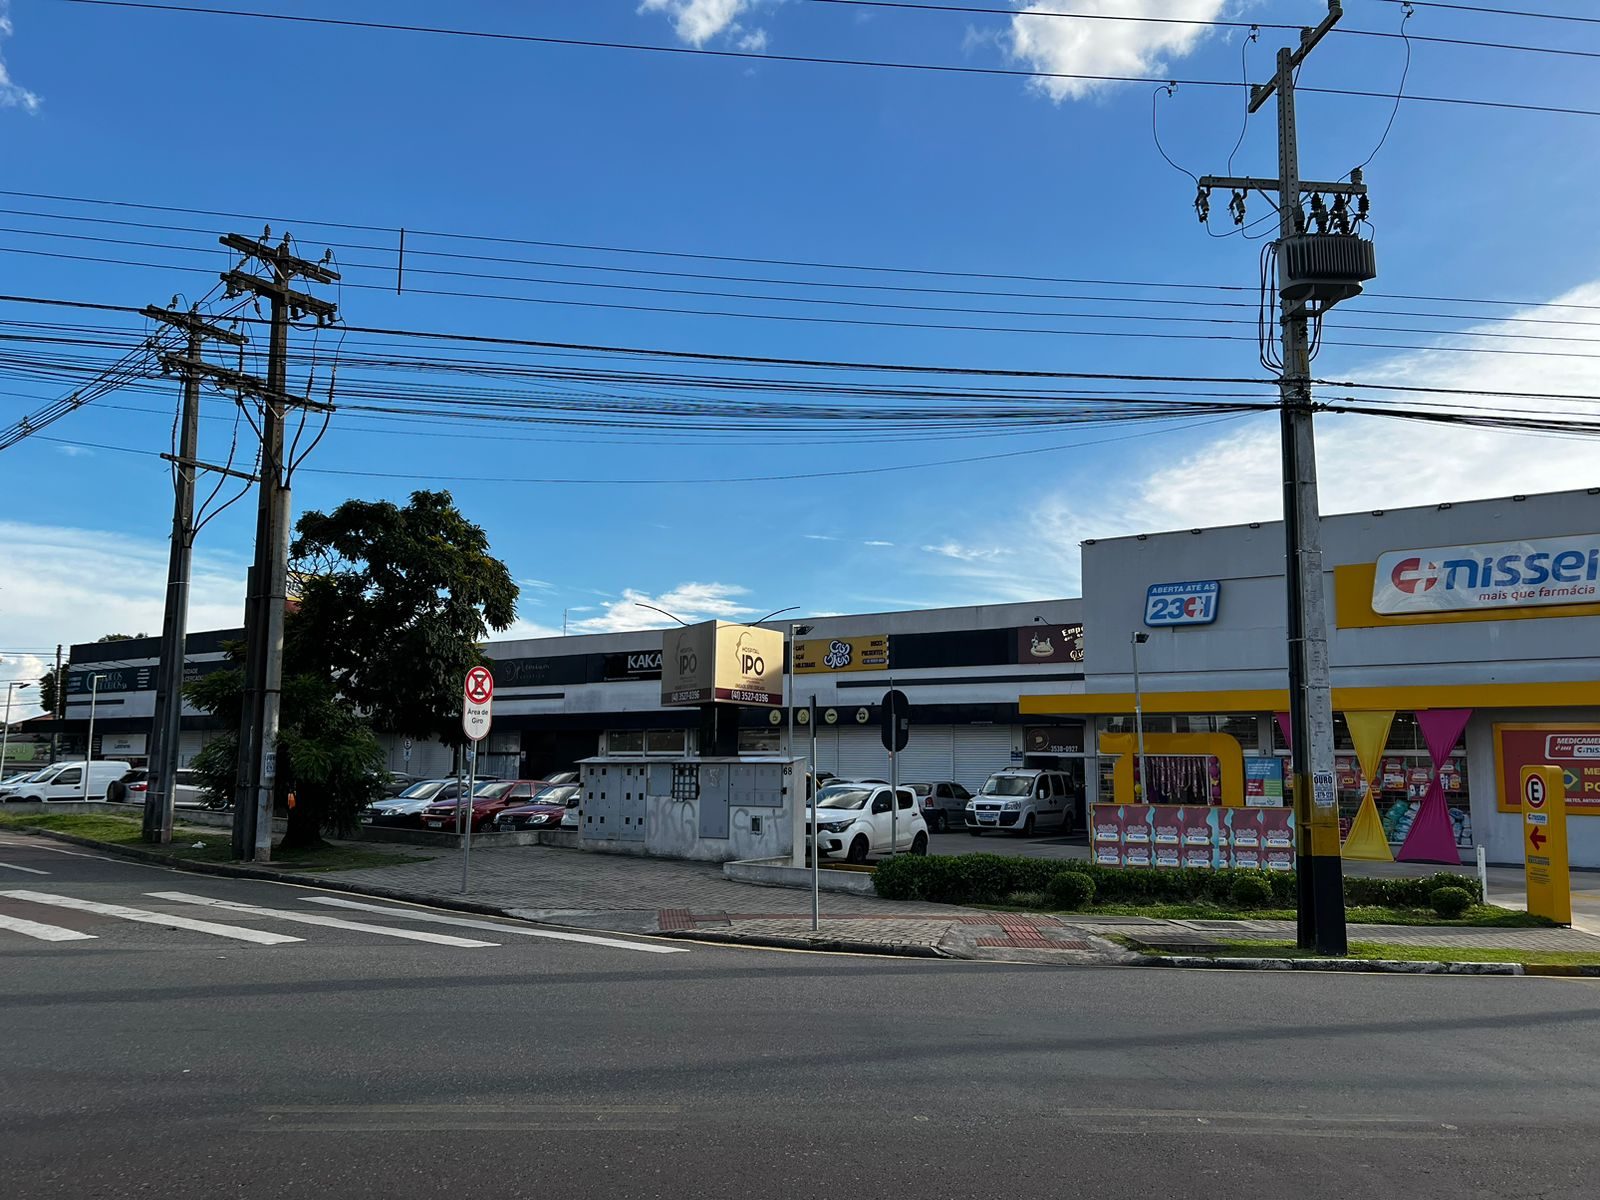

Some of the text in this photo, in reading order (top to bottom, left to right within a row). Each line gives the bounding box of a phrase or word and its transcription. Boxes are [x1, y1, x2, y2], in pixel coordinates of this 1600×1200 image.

[1443, 549, 1599, 590] nissei
[1152, 586, 1184, 594] ABERTA
[1479, 584, 1596, 602] mais que farmácia
[679, 653, 697, 676] IPO
[742, 654, 765, 676] IPO
[783, 767, 793, 775] 68
[1584, 767, 1600, 775] ME
[1314, 776, 1333, 784] OURO
[1584, 782, 1600, 792] PO
[1530, 780, 1541, 802] E
